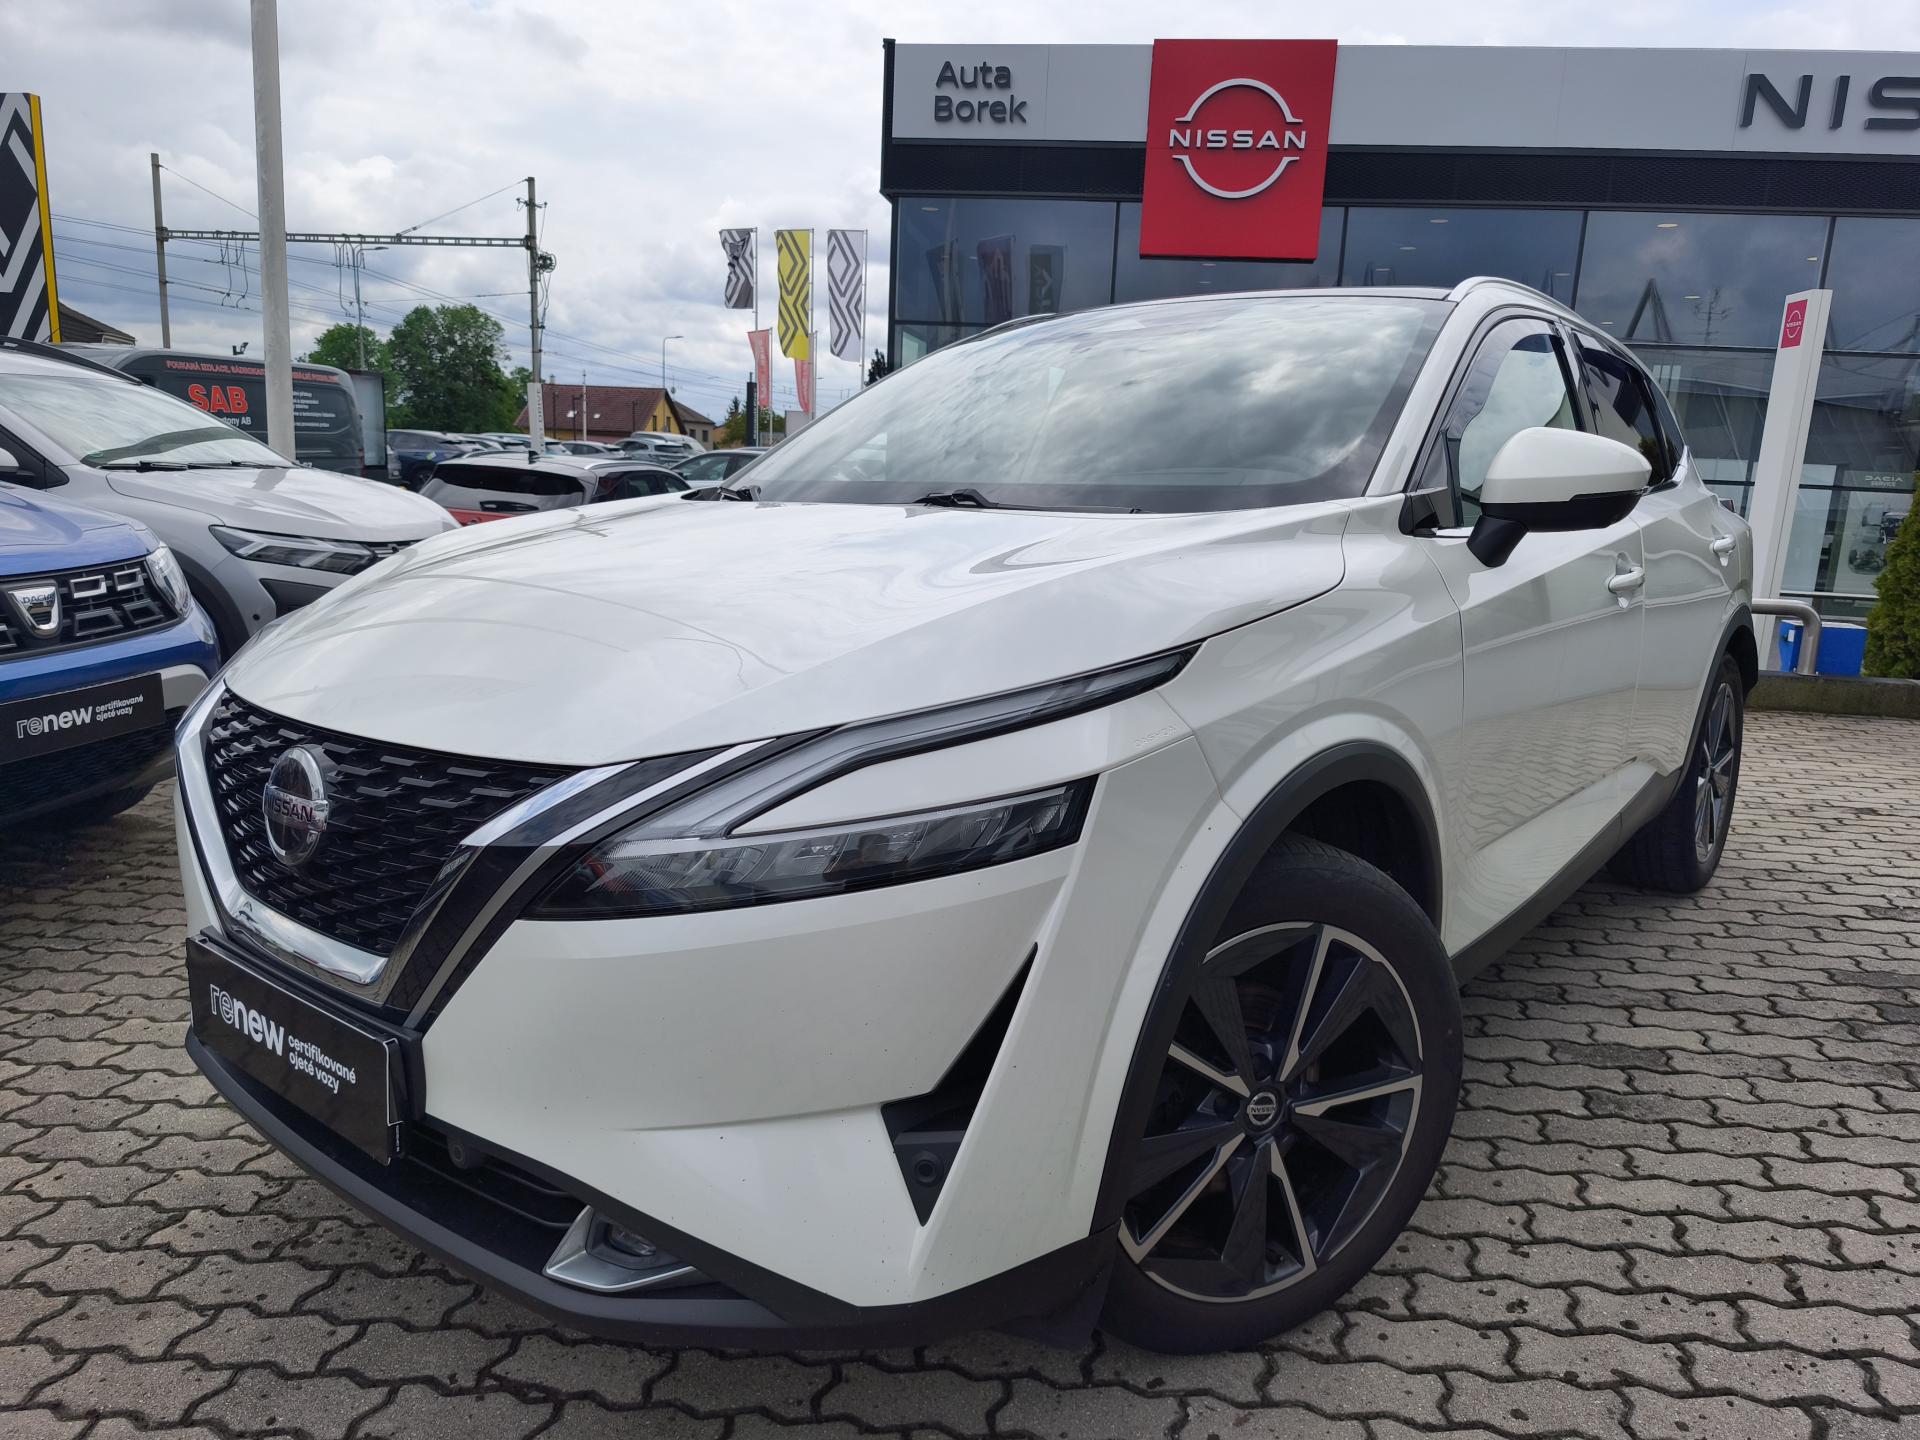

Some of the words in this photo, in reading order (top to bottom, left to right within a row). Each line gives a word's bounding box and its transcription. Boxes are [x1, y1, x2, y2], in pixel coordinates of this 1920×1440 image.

[935, 61, 1012, 88] Auta
[935, 94, 1027, 123] Borek
[1169, 129, 1306, 149] NISSAN
[188, 383, 248, 413] SAB
[241, 416, 252, 425] AB
[16, 706, 92, 738] renew
[96, 694, 144, 712] certifikované
[96, 710, 116, 722] ojeté
[116, 706, 133, 715] vozy
[210, 984, 285, 1056] renew
[288, 1035, 356, 1084] certifikované
[289, 1053, 314, 1075] ojeté
[315, 1067, 339, 1095] vozy
